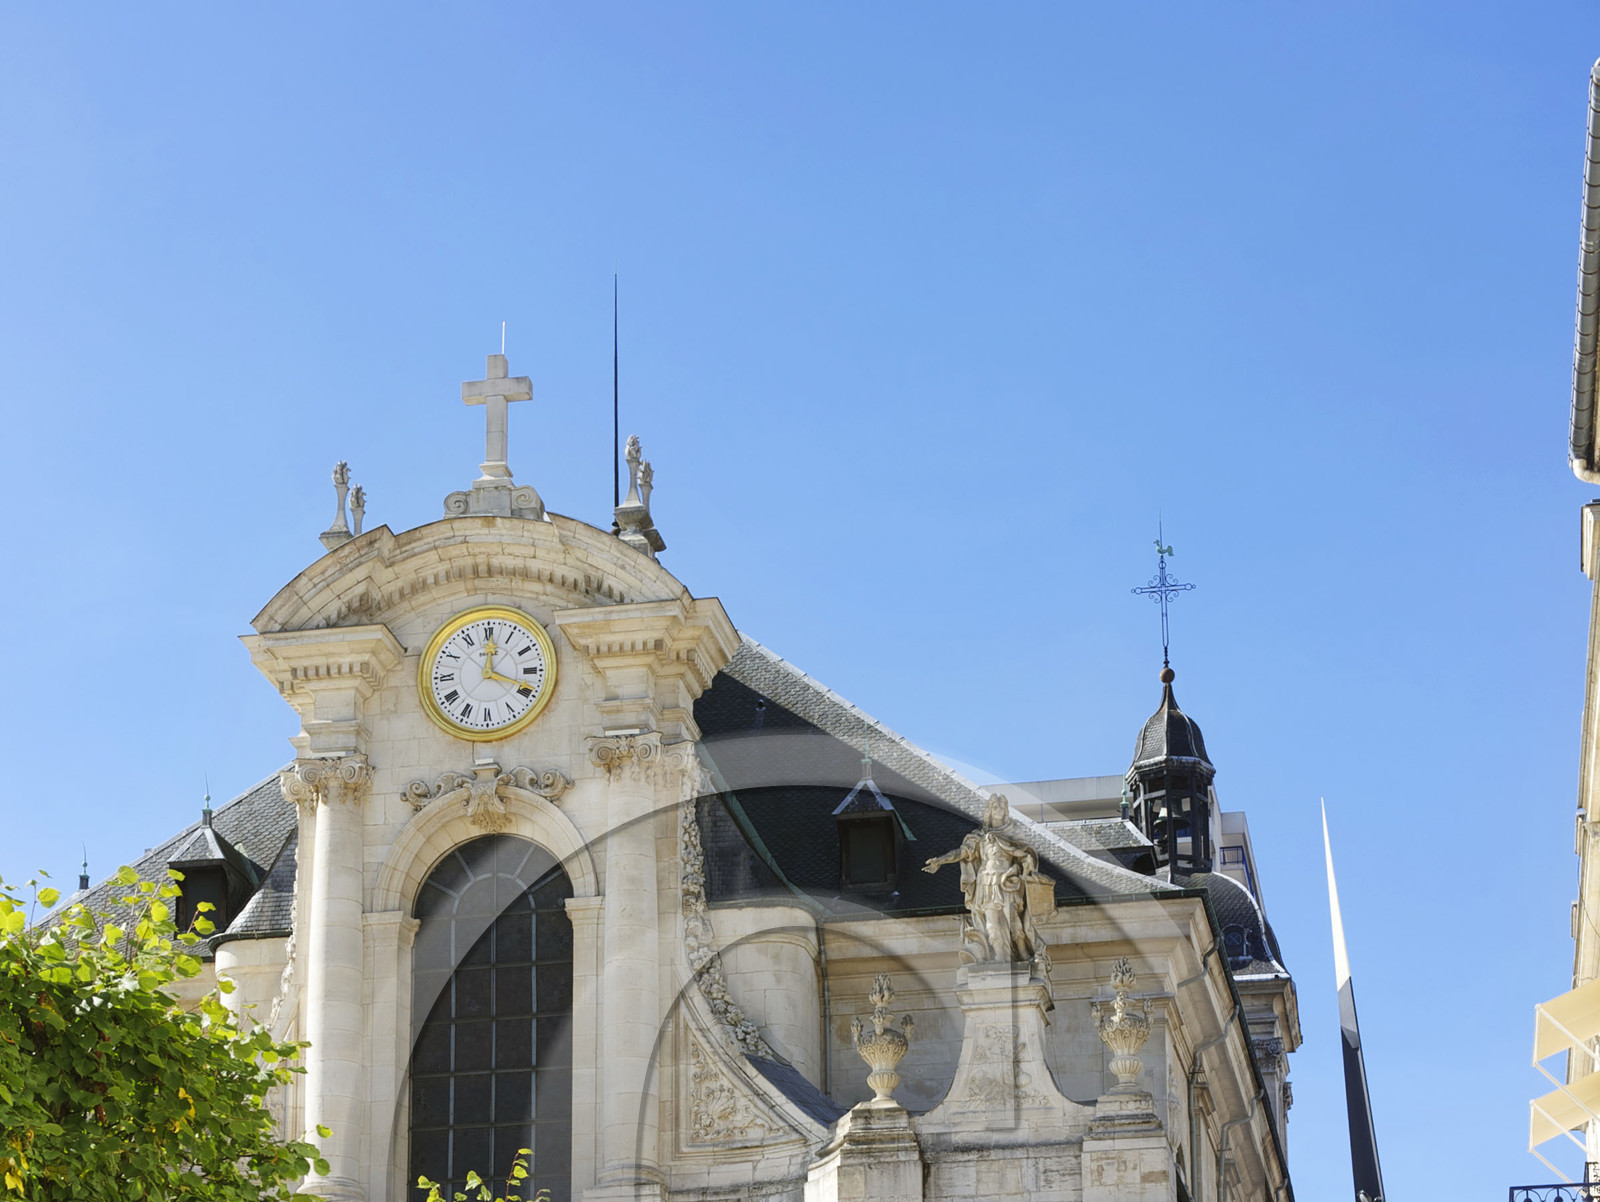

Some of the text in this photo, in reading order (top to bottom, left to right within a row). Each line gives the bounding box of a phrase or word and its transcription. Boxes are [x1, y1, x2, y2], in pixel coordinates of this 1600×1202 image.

[462, 633, 475, 649] XI
[505, 631, 514, 644] I
[446, 651, 460, 662] X
[517, 645, 532, 656] II
[440, 673, 454, 682] IX
[523, 667, 537, 675] III
[460, 703, 473, 719] VII
[505, 701, 515, 714] V
[483, 708, 492, 722] VI
